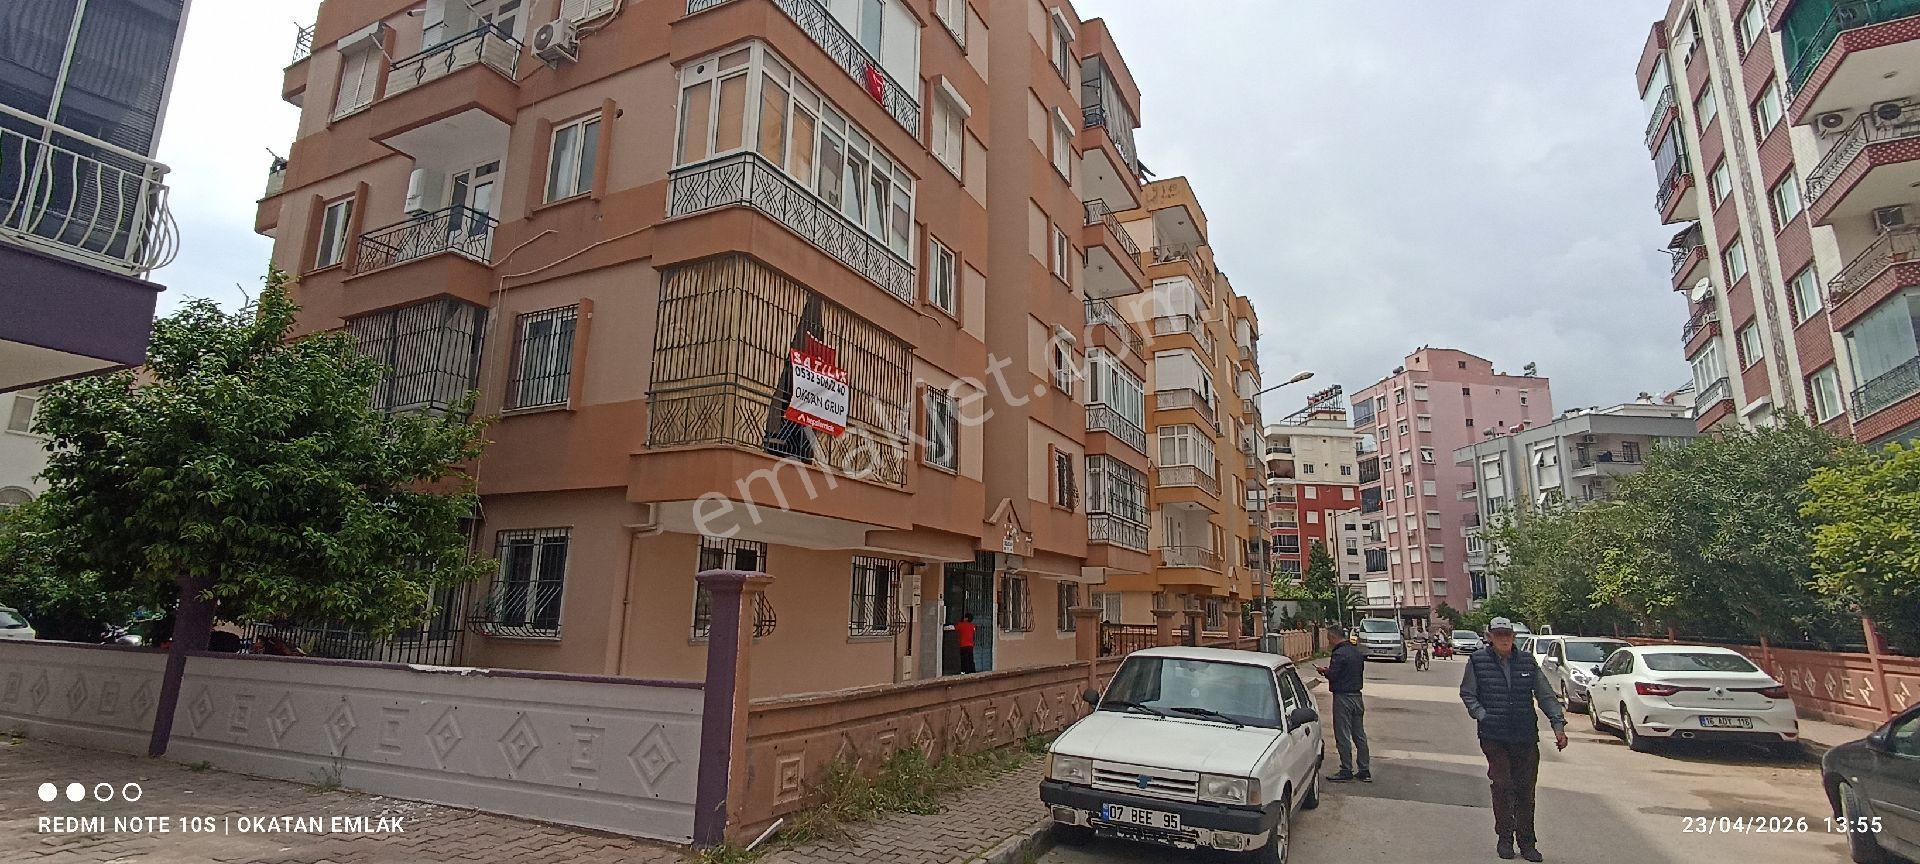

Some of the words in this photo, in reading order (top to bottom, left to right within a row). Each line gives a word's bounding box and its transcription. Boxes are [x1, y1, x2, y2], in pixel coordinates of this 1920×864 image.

[795, 366, 815, 382] 0532
[795, 387, 823, 408] OKATAN
[824, 399, 845, 416] GRUP
[1109, 806, 1124, 820] 07
[1131, 808, 1153, 825] BEE
[1163, 813, 1178, 829] 95
